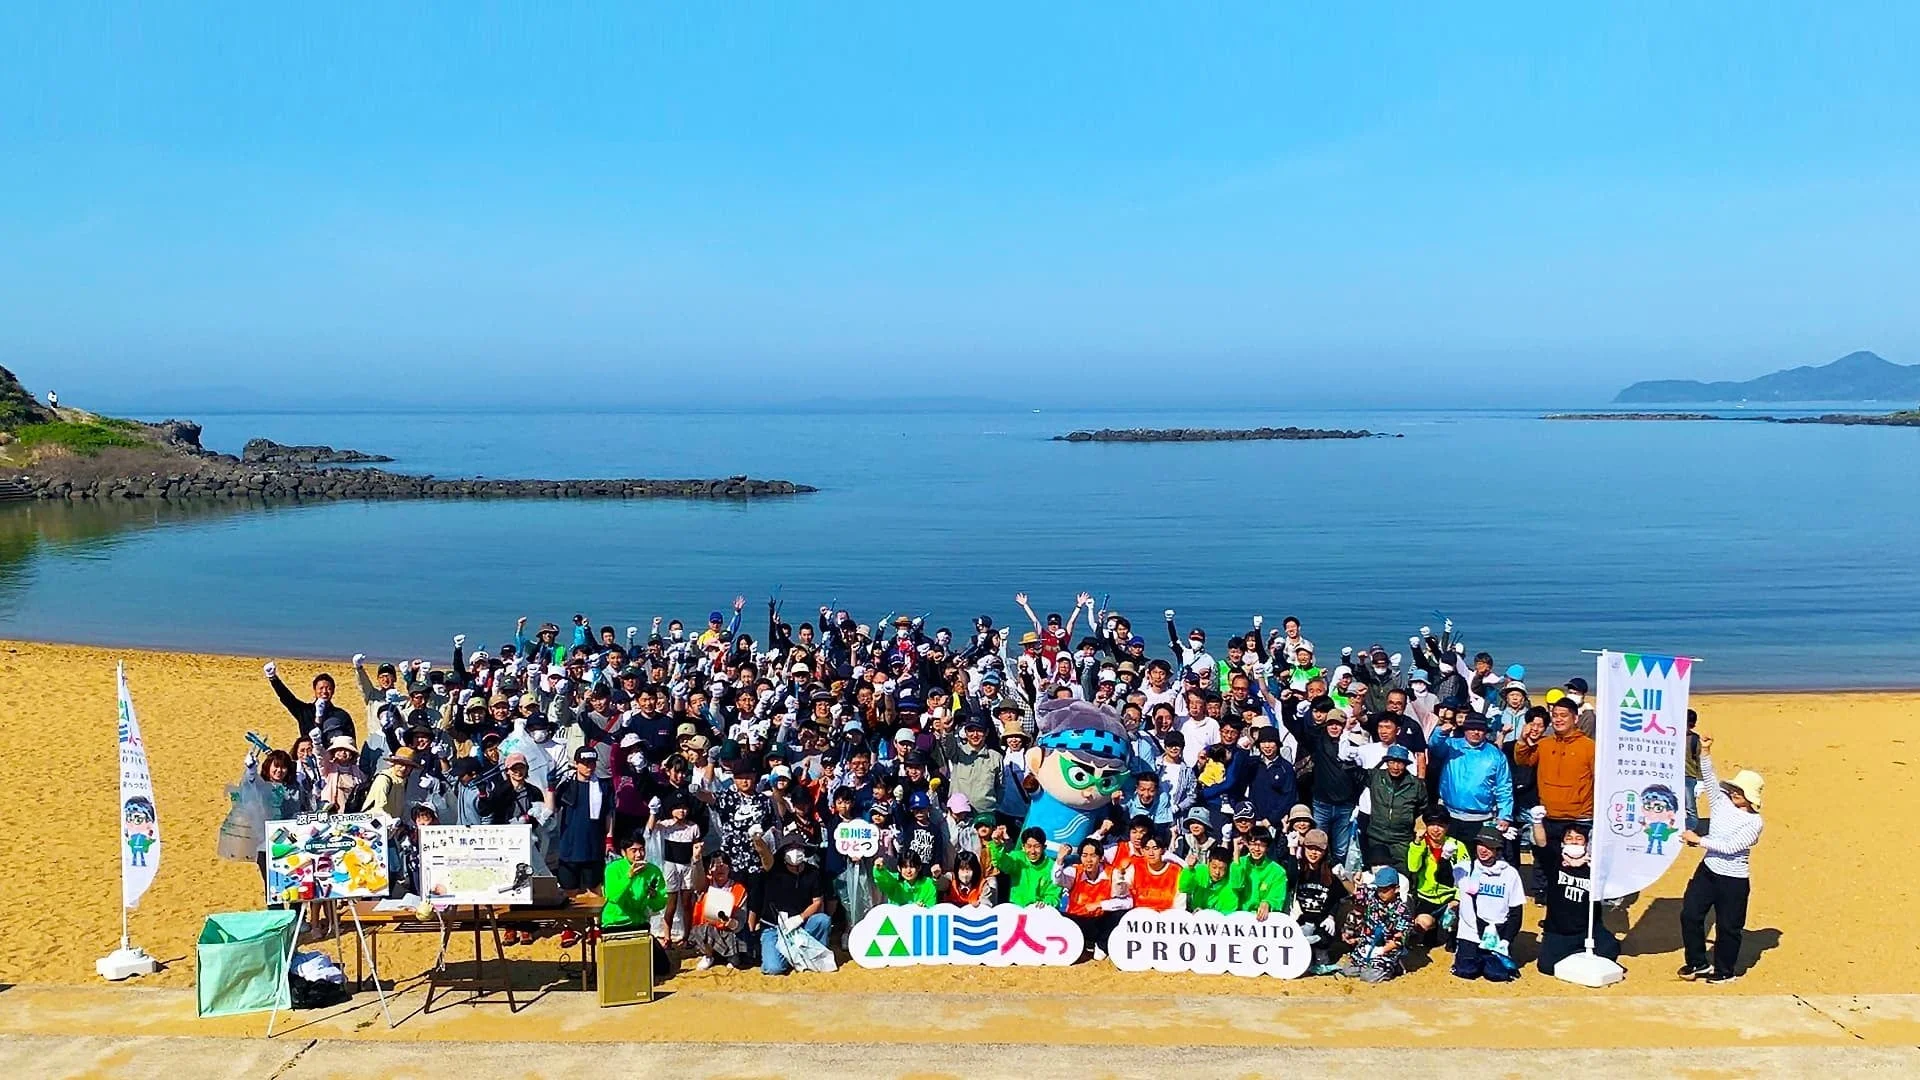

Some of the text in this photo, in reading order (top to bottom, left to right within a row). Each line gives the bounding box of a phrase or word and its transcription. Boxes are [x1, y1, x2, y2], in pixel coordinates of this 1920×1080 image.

[1618, 743, 1676, 756] PROJECT
[1613, 803, 1624, 831] ひとつ
[841, 841, 872, 851] ひとつ
[1565, 886, 1585, 903] CITY
[1126, 920, 1294, 939] MORIKAWAKAITO
[1126, 940, 1293, 966] PROJECT
